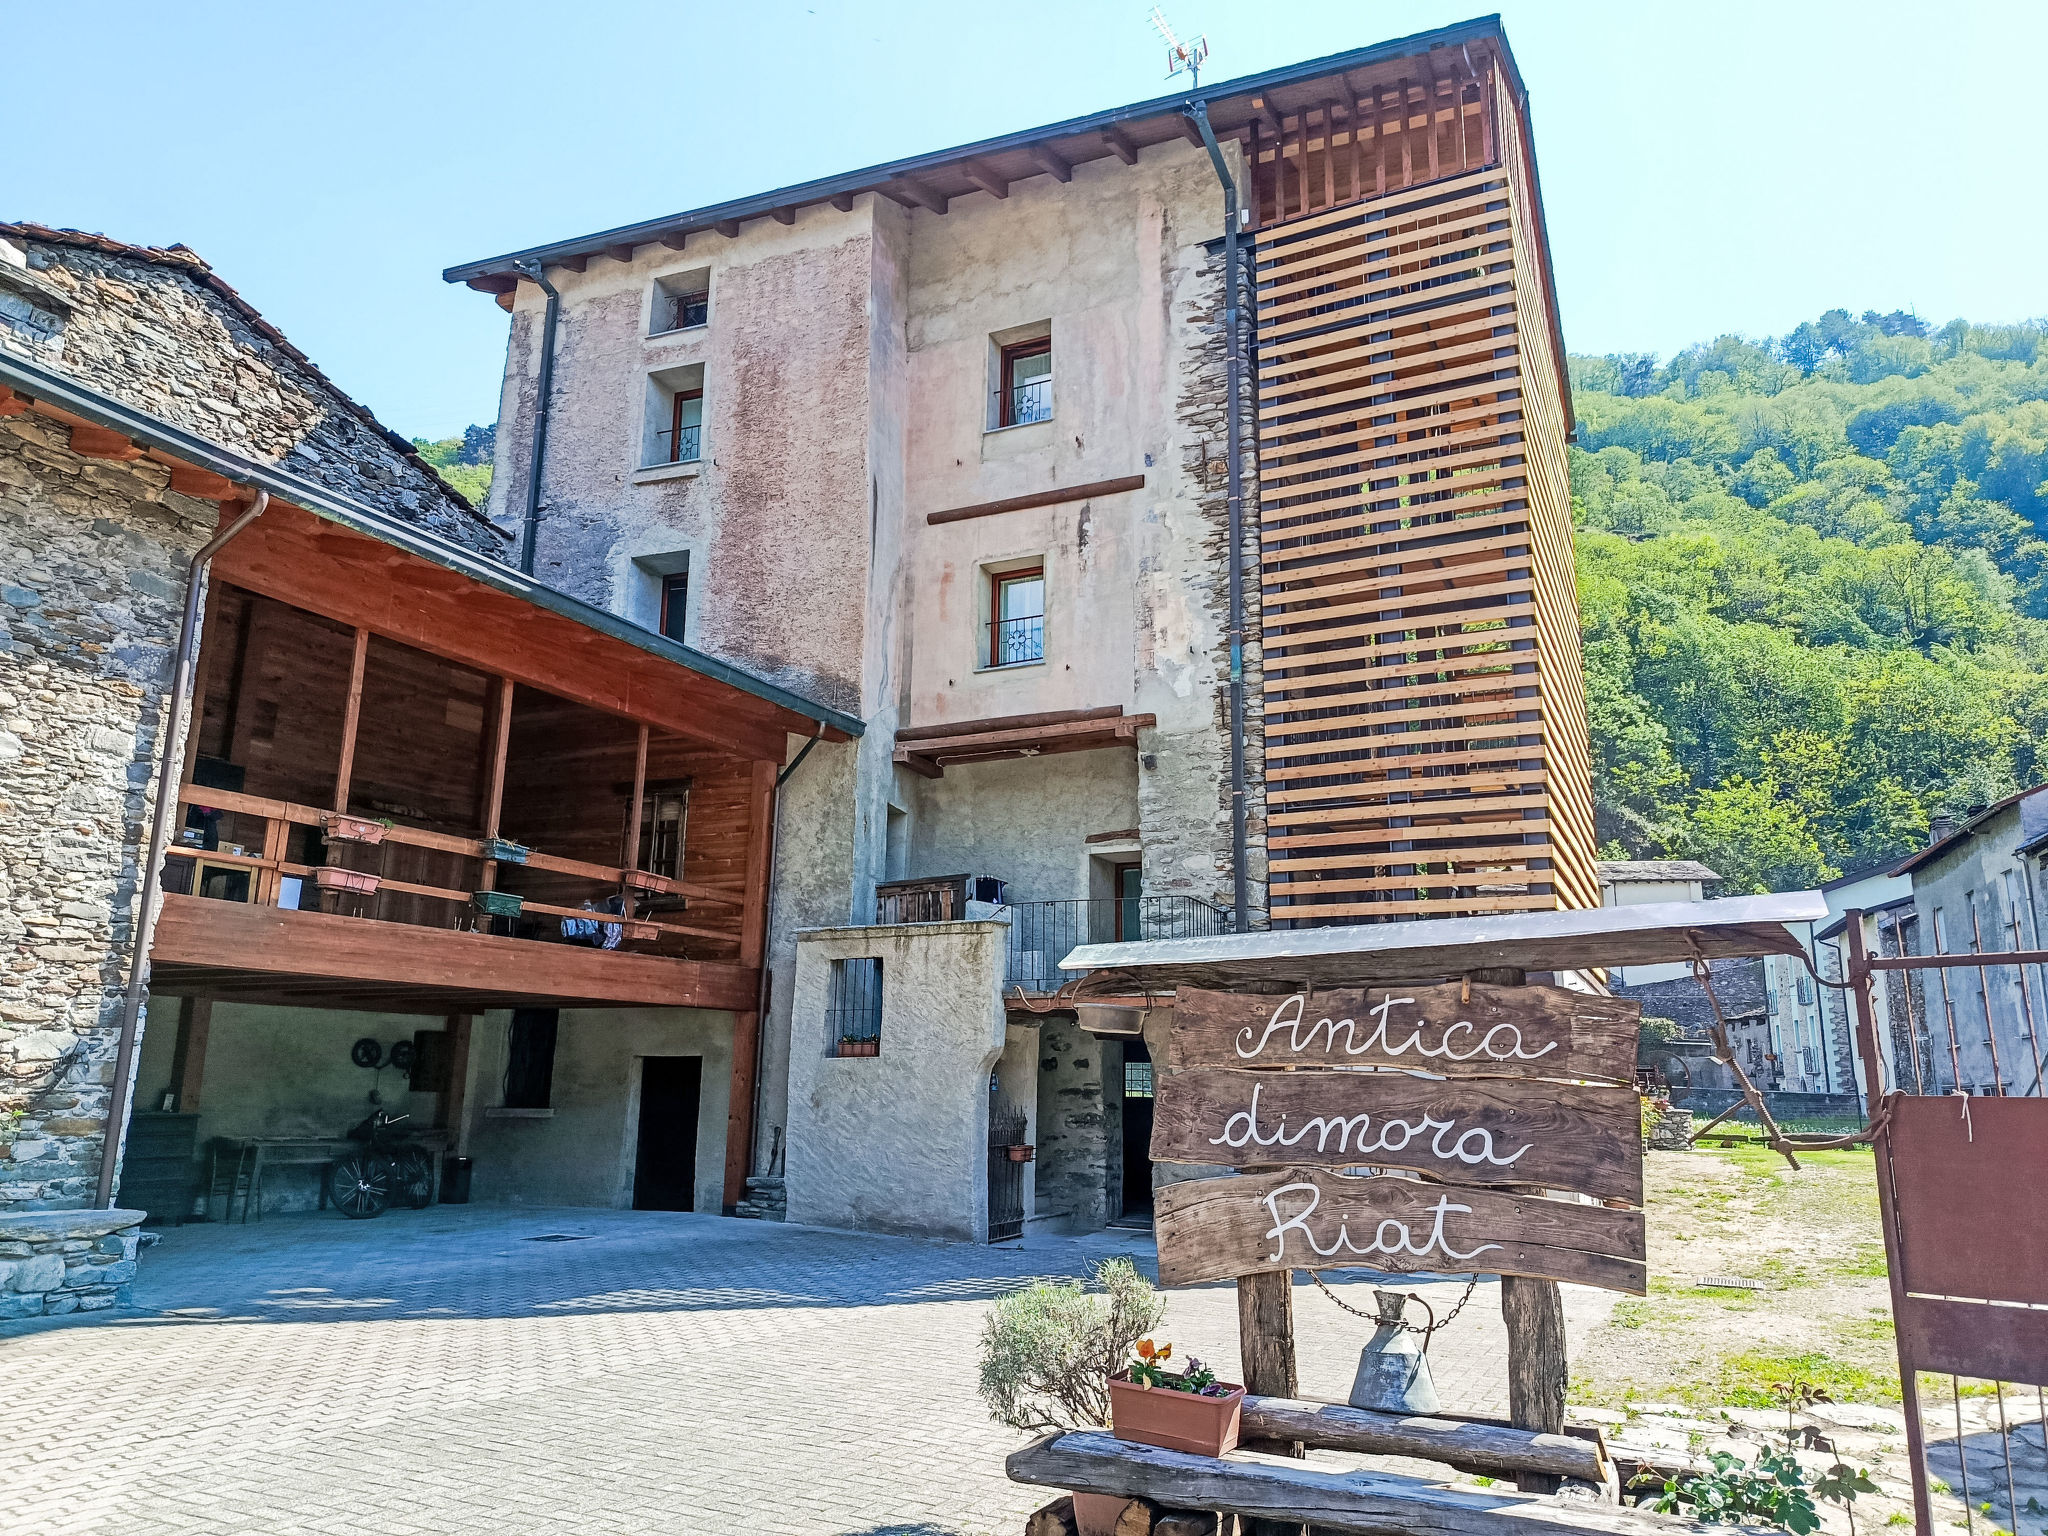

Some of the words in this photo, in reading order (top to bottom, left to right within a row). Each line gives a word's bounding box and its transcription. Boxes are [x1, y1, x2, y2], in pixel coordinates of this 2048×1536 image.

[1235, 993, 1558, 1062] Antica
[1208, 1082, 1534, 1166] dimora
[1262, 1182, 1505, 1263] Riat
